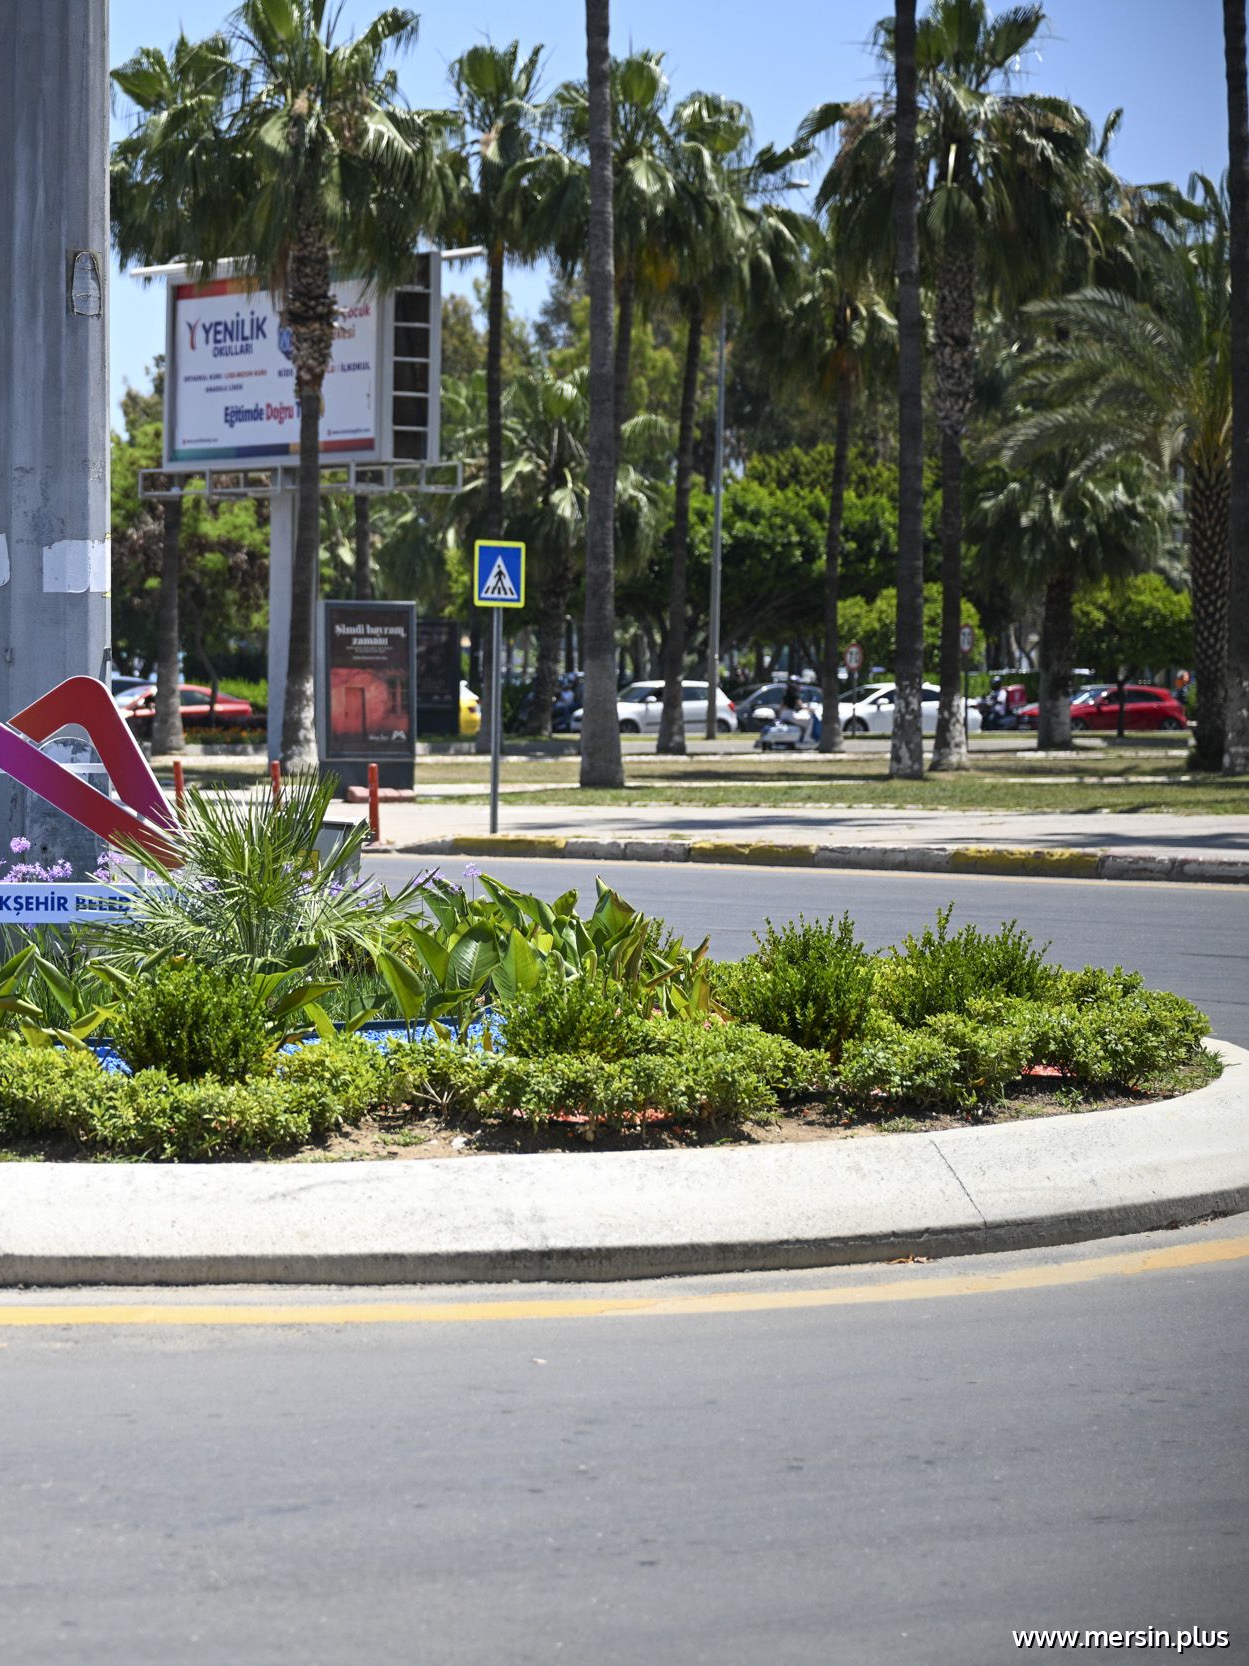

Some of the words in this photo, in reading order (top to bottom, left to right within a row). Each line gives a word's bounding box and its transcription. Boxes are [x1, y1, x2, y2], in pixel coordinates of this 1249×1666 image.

[202, 310, 267, 345] YENİLİK
[213, 343, 253, 358] OKULLARI
[224, 403, 264, 428] Eğitimde
[266, 402, 294, 425] Doğru
